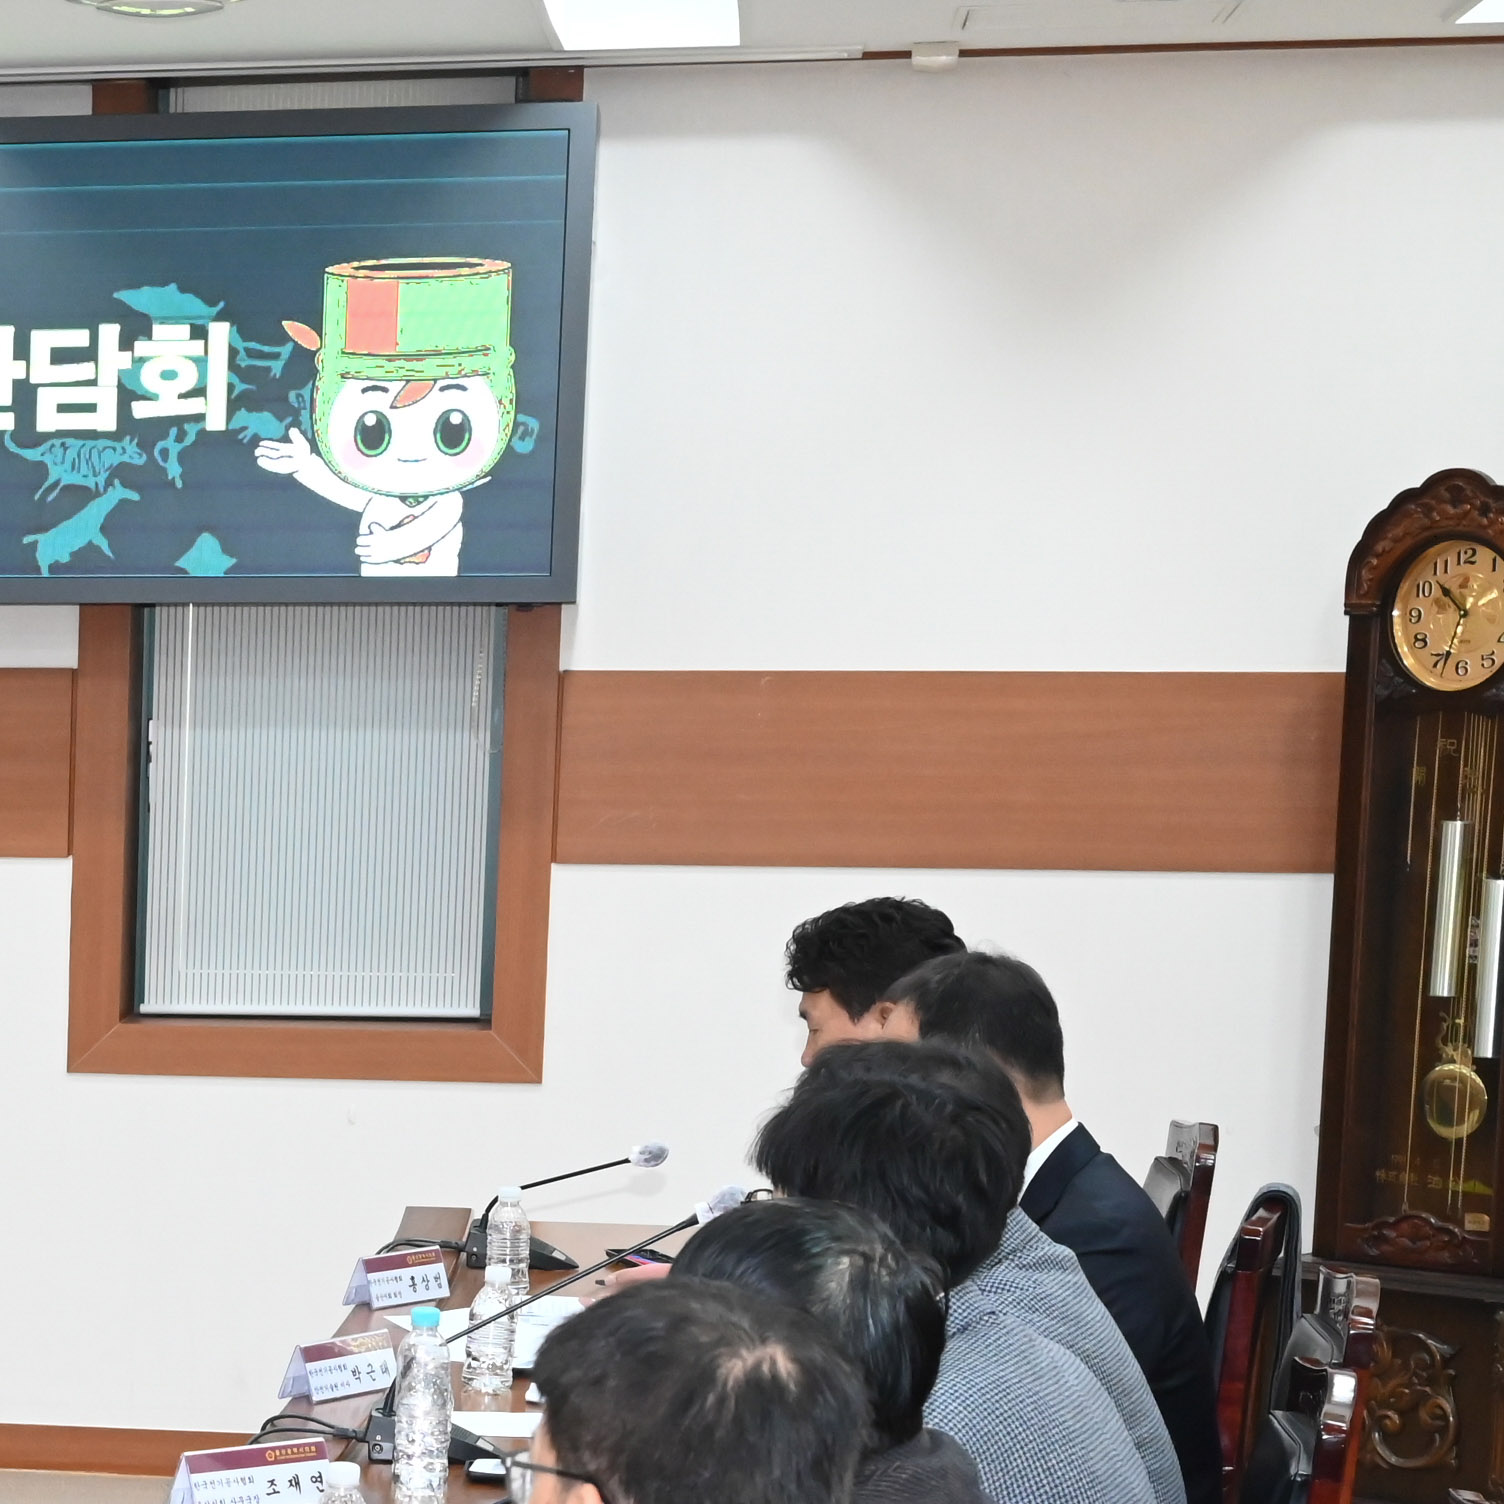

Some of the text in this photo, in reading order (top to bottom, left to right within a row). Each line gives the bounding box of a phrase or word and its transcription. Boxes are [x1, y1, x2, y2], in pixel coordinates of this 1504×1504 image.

[1457, 547, 1477, 566] 12
[1492, 555, 1497, 573] 1
[1433, 557, 1450, 576] 11
[1416, 580, 1433, 598] 10
[1409, 607, 1422, 624] 9
[1413, 632, 1428, 649] 8
[1430, 652, 1445, 668] 7
[1455, 660, 1469, 676] 6
[1481, 650, 1496, 668] 5
[409, 1272, 443, 1293] 홍상범
[266, 1471, 325, 1496] 조재연
